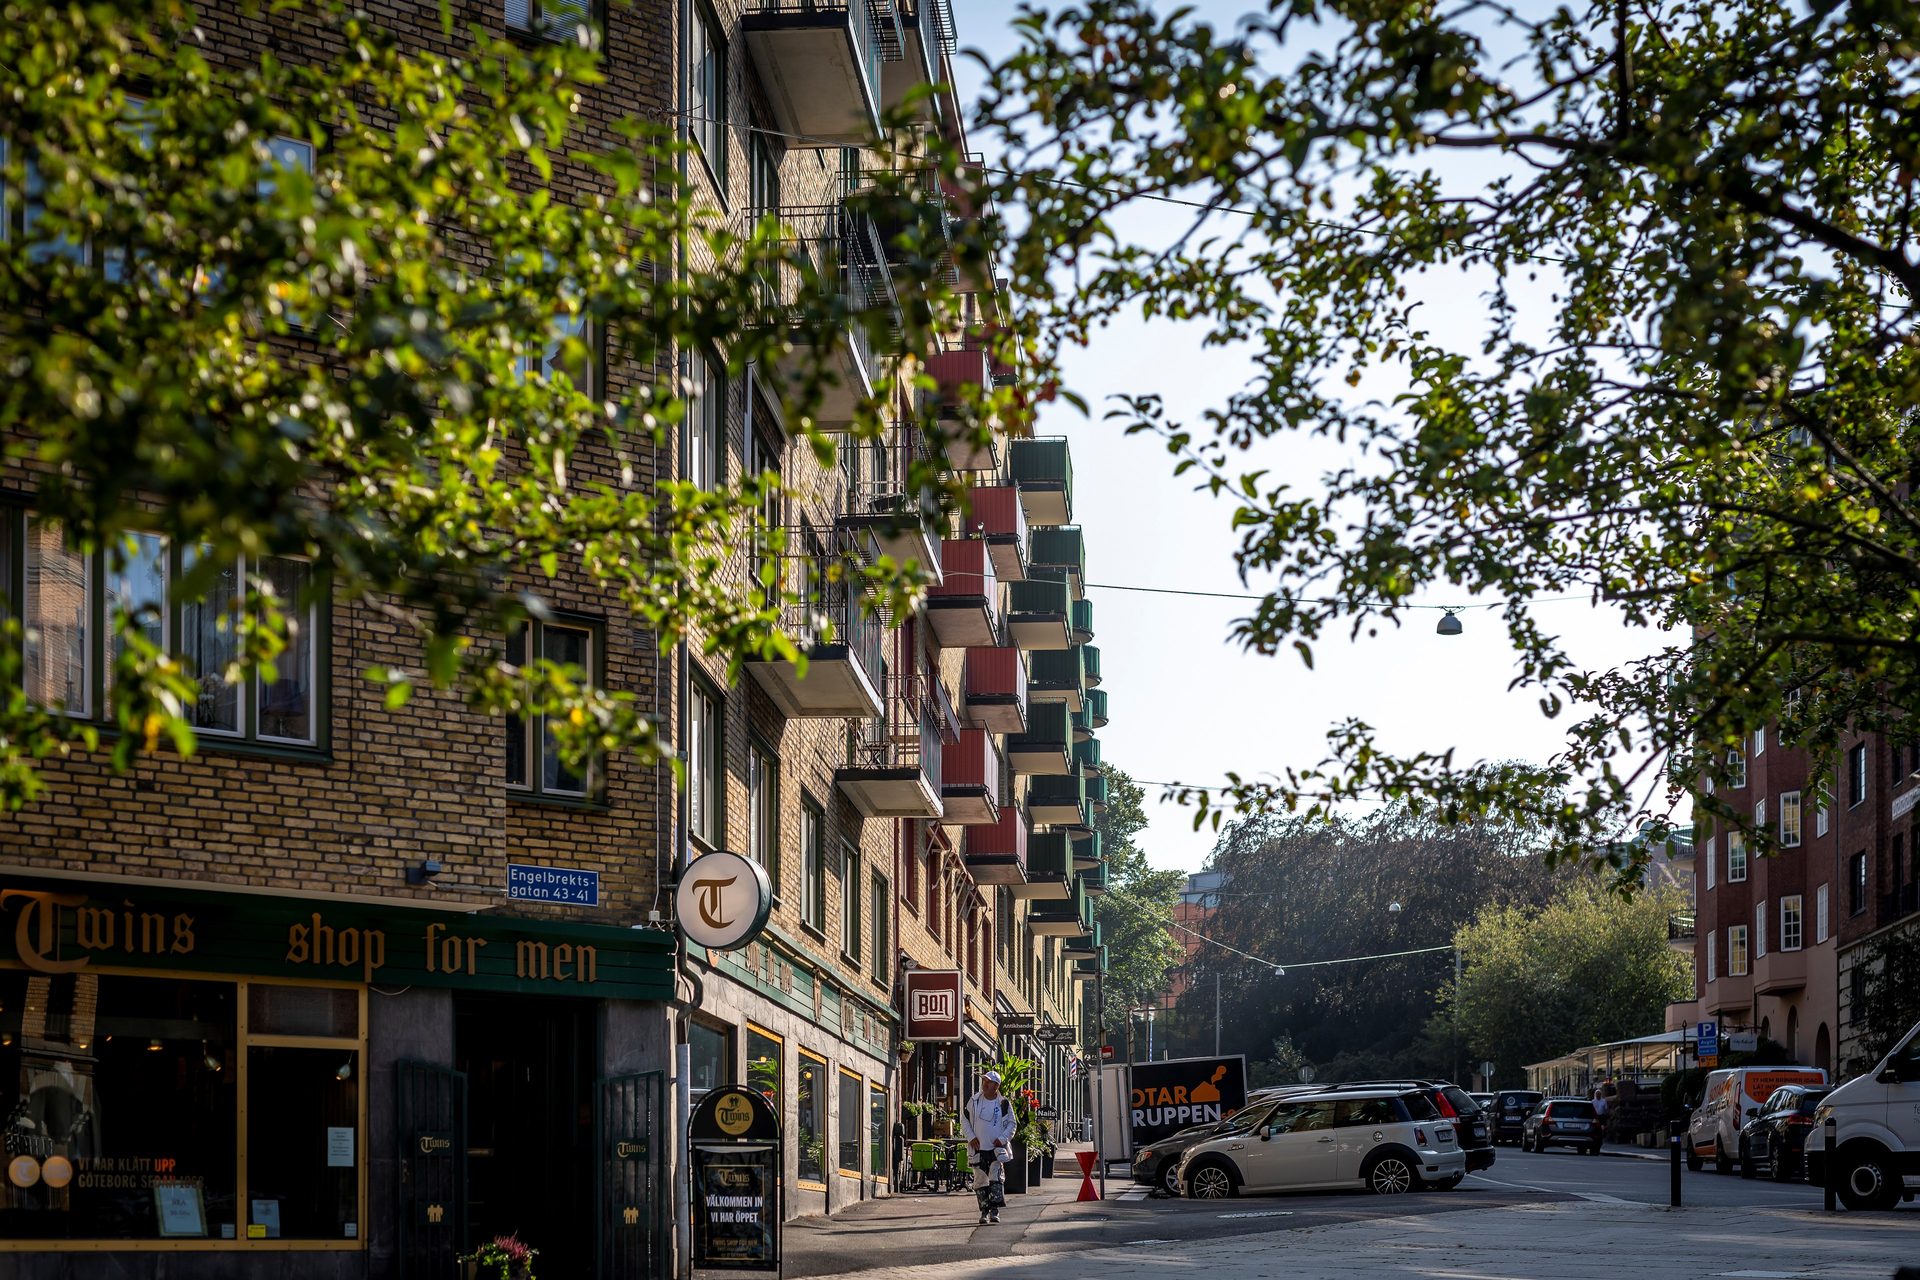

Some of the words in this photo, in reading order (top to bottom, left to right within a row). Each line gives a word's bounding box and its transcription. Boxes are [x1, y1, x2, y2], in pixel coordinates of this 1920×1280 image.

[511, 869, 595, 886] Engelbrekts-
[511, 886, 549, 898] gatan
[553, 888, 588, 901] 43-41
[692, 875, 738, 929] T
[0, 888, 196, 975] Twins
[285, 912, 386, 983] shop
[421, 922, 488, 976] for
[516, 938, 599, 984] men
[1703, 1023, 1712, 1037] P
[718, 1107, 750, 1126] Twins
[1037, 1109, 1056, 1117] Nails
[420, 1135, 451, 1154] Twins
[617, 1141, 647, 1159] Twins
[78, 1158, 89, 1171] VI
[93, 1158, 114, 1171] HAR
[118, 1156, 151, 1171] KLÄTT
[153, 1158, 176, 1172] UPP
[78, 1172, 136, 1188] GÖTEBORG
[718, 1168, 750, 1187] Twins
[706, 1194, 753, 1207] VÄLKOMMEN
[755, 1196, 763, 1207] IN
[710, 1212, 718, 1223] VI
[720, 1212, 734, 1223] HAR
[735, 1209, 758, 1223] ÖPPET
